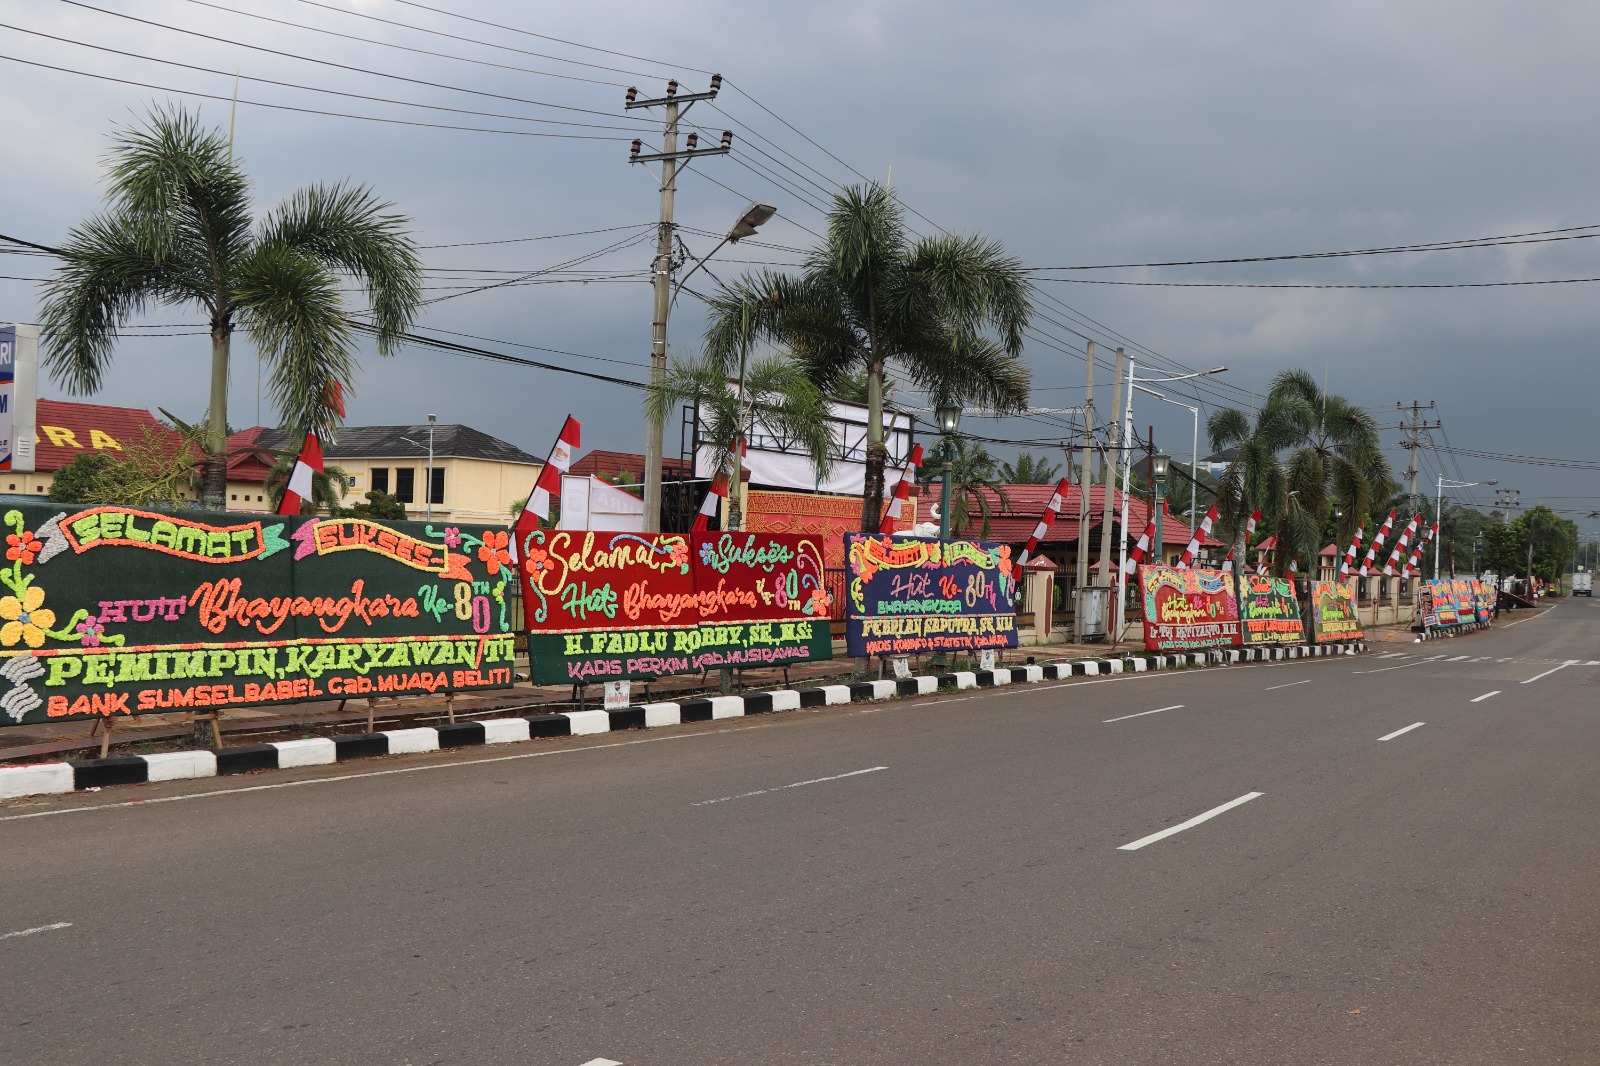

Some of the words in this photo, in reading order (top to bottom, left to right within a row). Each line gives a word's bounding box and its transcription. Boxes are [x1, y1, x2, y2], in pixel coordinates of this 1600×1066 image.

[72, 512, 254, 558] SELAMAT
[538, 531, 660, 595] Selamat
[708, 533, 794, 574] Sukses
[98, 595, 187, 623] HUT
[188, 577, 419, 634] Bhayangkara
[623, 578, 757, 622] Bhayangkara
[47, 692, 131, 717] BANK
[453, 667, 511, 688] BELITI
[567, 659, 623, 681] KADIS
[626, 656, 689, 676] PERKIM
